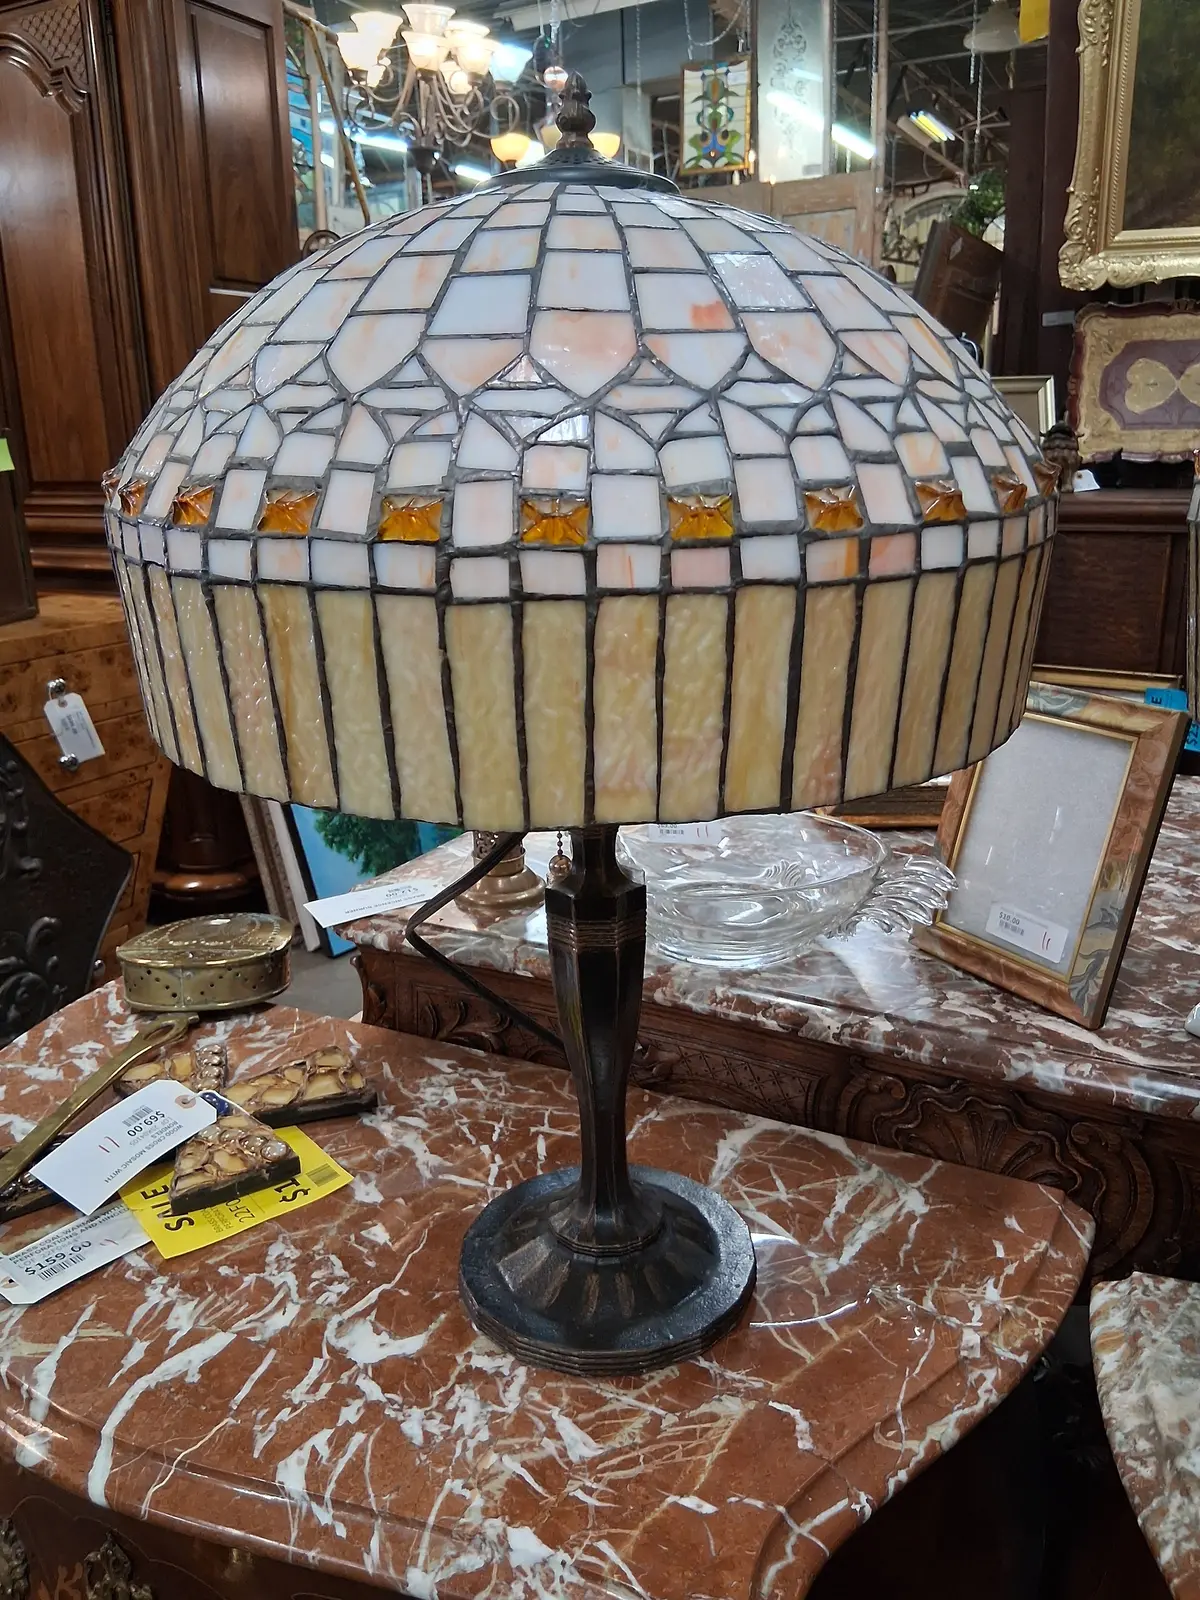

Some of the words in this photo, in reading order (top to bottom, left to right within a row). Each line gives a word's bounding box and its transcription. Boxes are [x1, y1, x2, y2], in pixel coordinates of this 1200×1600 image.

[127, 1110, 165, 1137] $69.00
[150, 1121, 179, 1139] RONDELS
[165, 1124, 184, 1137] WOOD
[144, 1135, 166, 1151] CROSS
[121, 1149, 147, 1170] MOSAIC
[104, 1168, 123, 1184] WITH
[273, 1178, 311, 1203] $1
[210, 1207, 234, 1230] PERFORAT
[226, 1198, 256, 1223] 22F0
[9, 1245, 39, 1262] BRASS
[39, 1234, 60, 1247] COAL
[61, 1215, 101, 1235] WARMER
[102, 1204, 124, 1217] WITH
[13, 1231, 78, 1265] PERFORATIONS
[80, 1222, 98, 1234] AND
[98, 1207, 130, 1225] HINGED
[24, 1240, 92, 1276] $159.00
